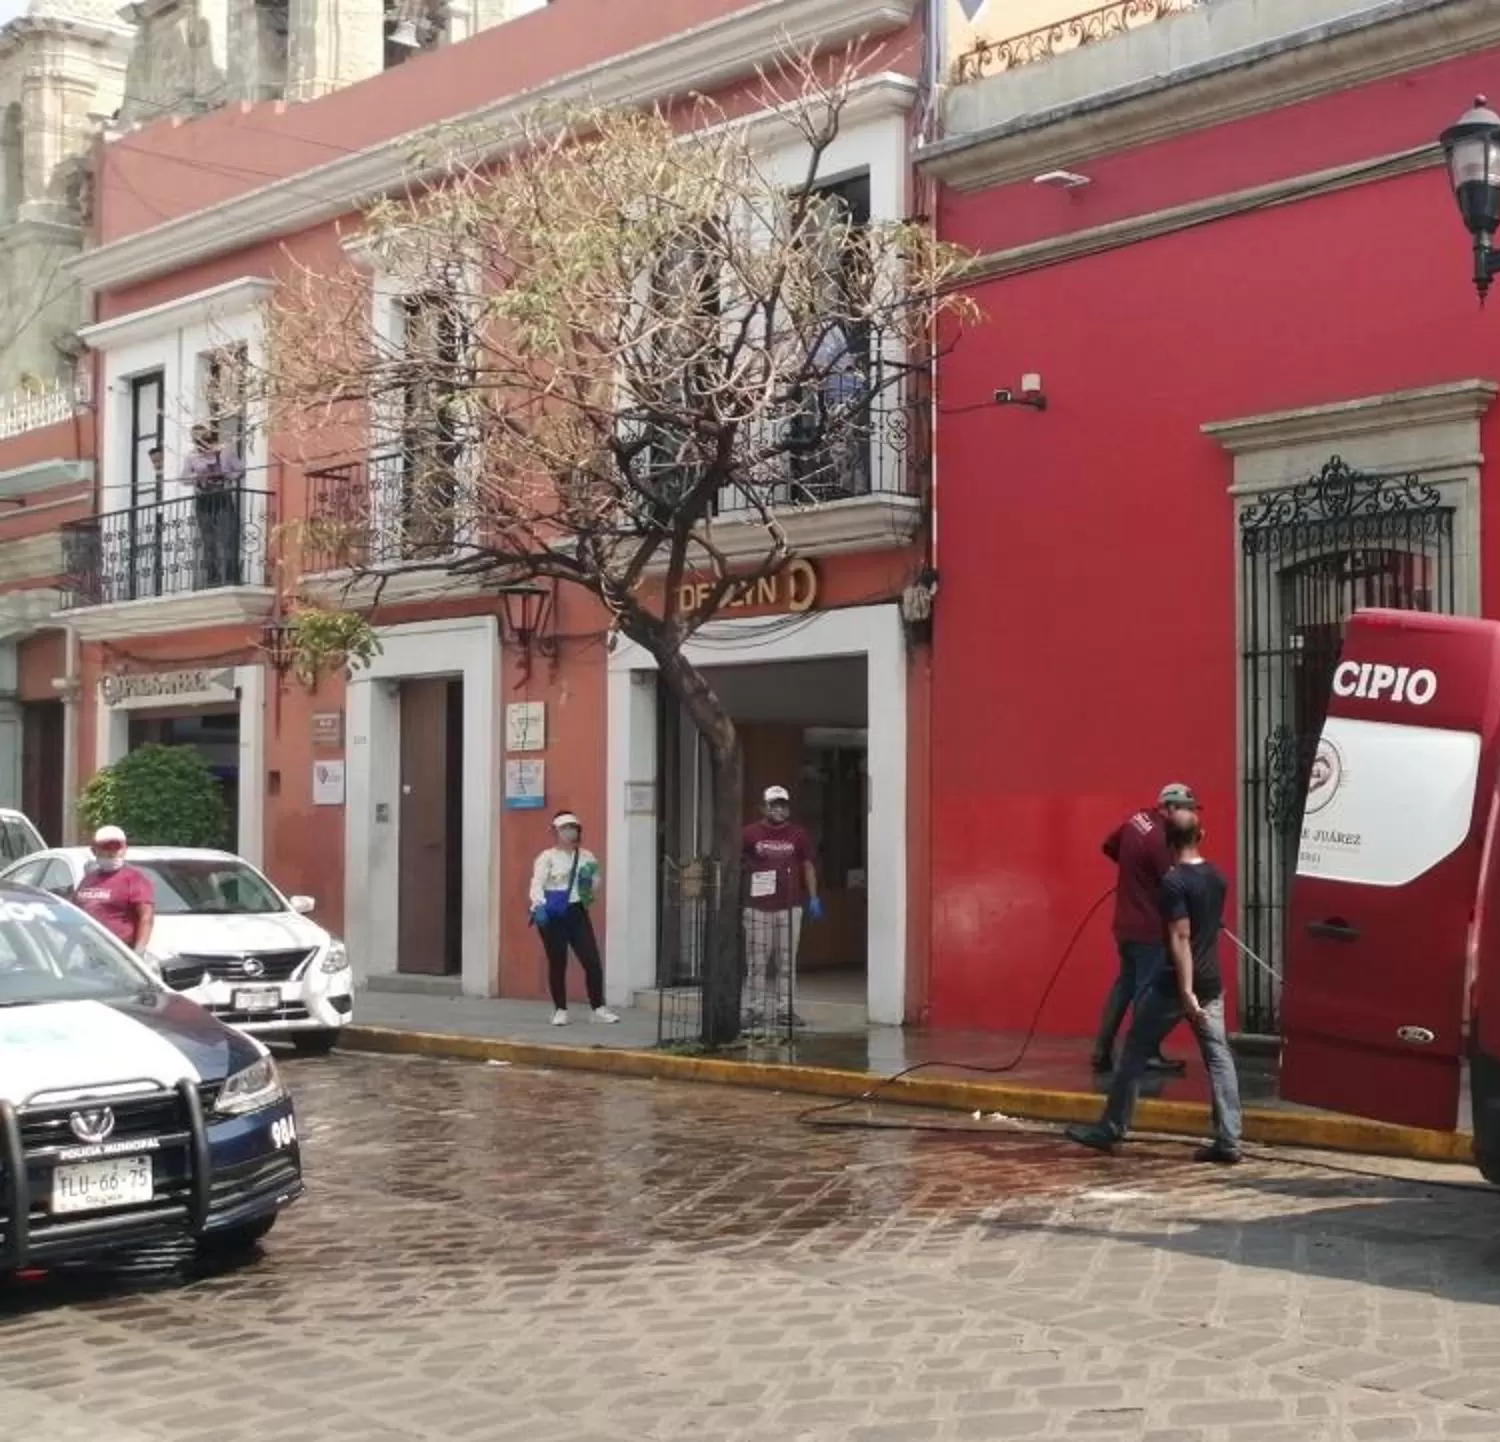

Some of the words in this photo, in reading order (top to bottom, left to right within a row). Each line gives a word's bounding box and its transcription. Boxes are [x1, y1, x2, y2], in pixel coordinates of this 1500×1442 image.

[1332, 661, 1438, 705] CIPIO
[60, 1146, 104, 1160] POLICIA
[104, 1137, 160, 1153] MUNICIPAL
[59, 1168, 148, 1198] TLU-66-75
